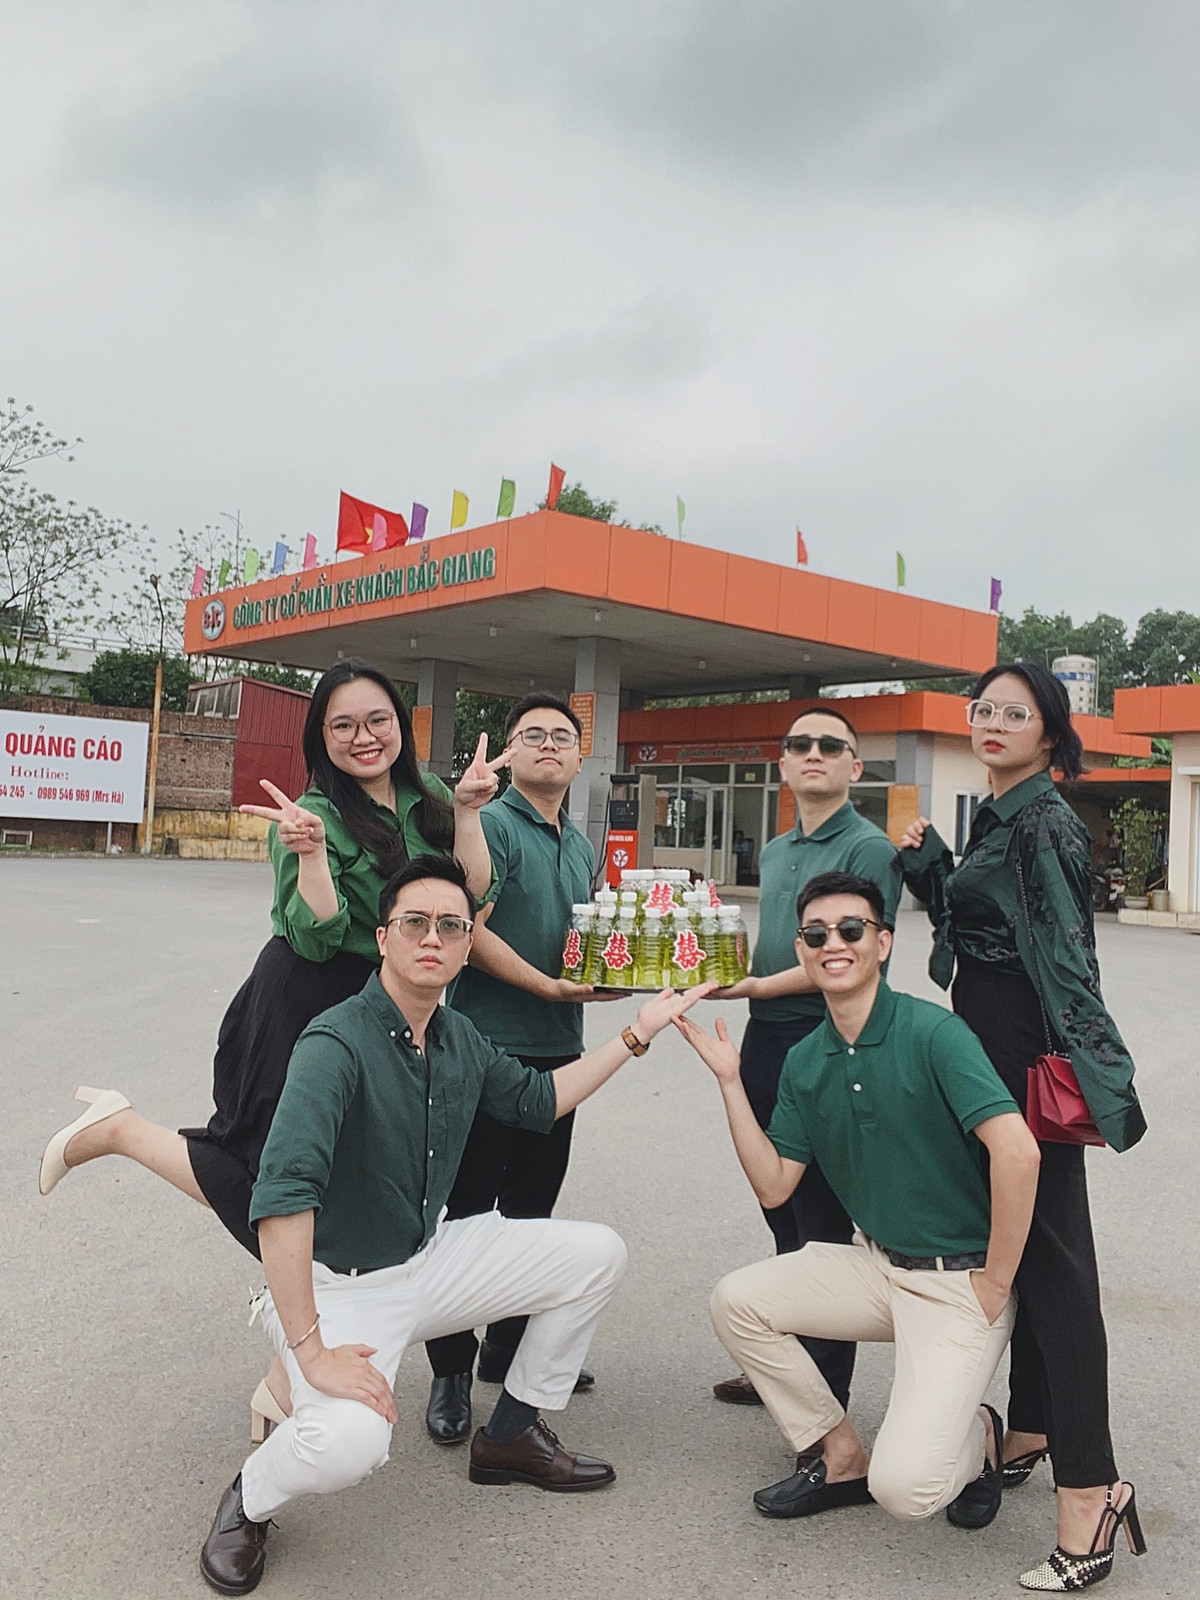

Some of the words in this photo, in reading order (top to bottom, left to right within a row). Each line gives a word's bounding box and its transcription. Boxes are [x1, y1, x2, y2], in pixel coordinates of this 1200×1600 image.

[233, 596, 263, 629] CÔNG
[265, 597, 279, 624] TY
[281, 578, 299, 619] CỔ
[298, 572, 335, 617] PHẦN
[336, 579, 356, 610] XE
[356, 563, 405, 605] KHÁCH
[406, 544, 439, 596] BẮC
[442, 547, 496, 587] GIANG
[5, 725, 76, 758] QUẢNG
[83, 735, 122, 761] CÁO
[10, 765, 69, 780] Hotline:
[10, 785, 25, 798] 245
[37, 786, 57, 800] 0989
[59, 787, 74, 801] 546
[76, 788, 90, 802] 969
[92, 790, 109, 803] (Mrs
